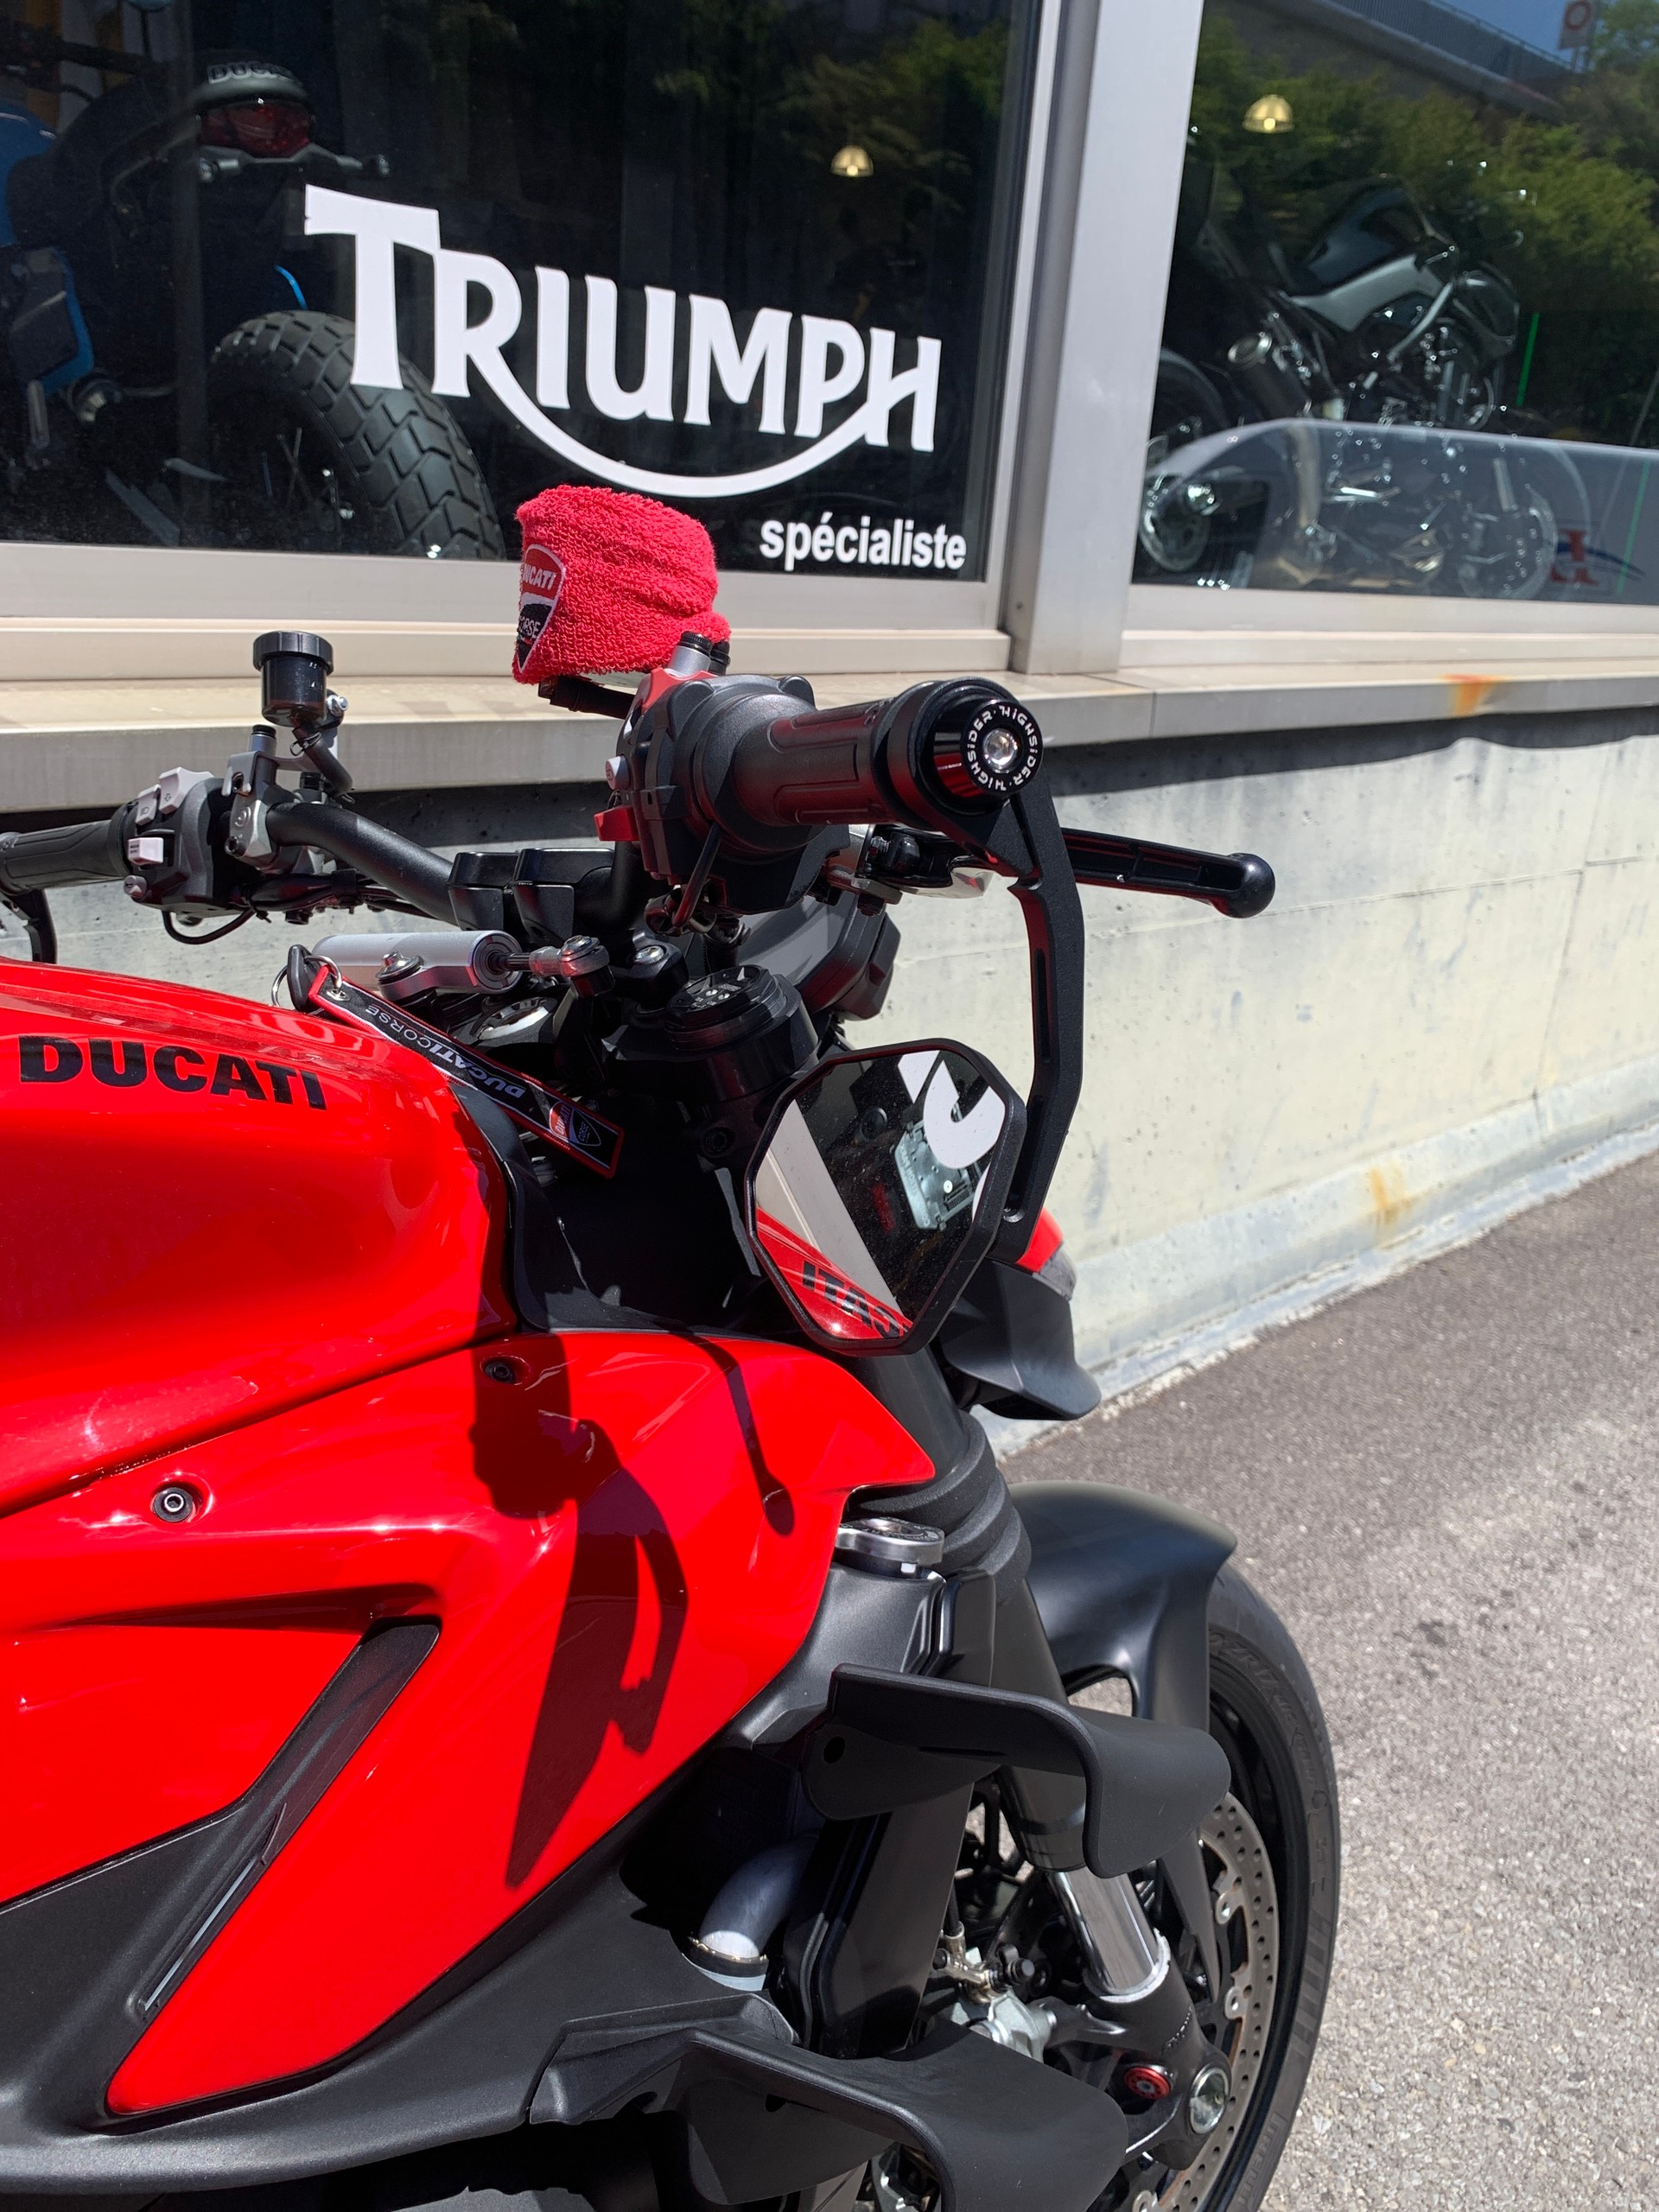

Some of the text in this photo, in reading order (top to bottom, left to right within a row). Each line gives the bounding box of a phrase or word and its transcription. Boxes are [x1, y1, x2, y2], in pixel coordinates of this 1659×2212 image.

[304, 184, 942, 498] TRIUMPH
[760, 512, 967, 571] spécialiste
[18, 1035, 327, 1111] DUCATI
